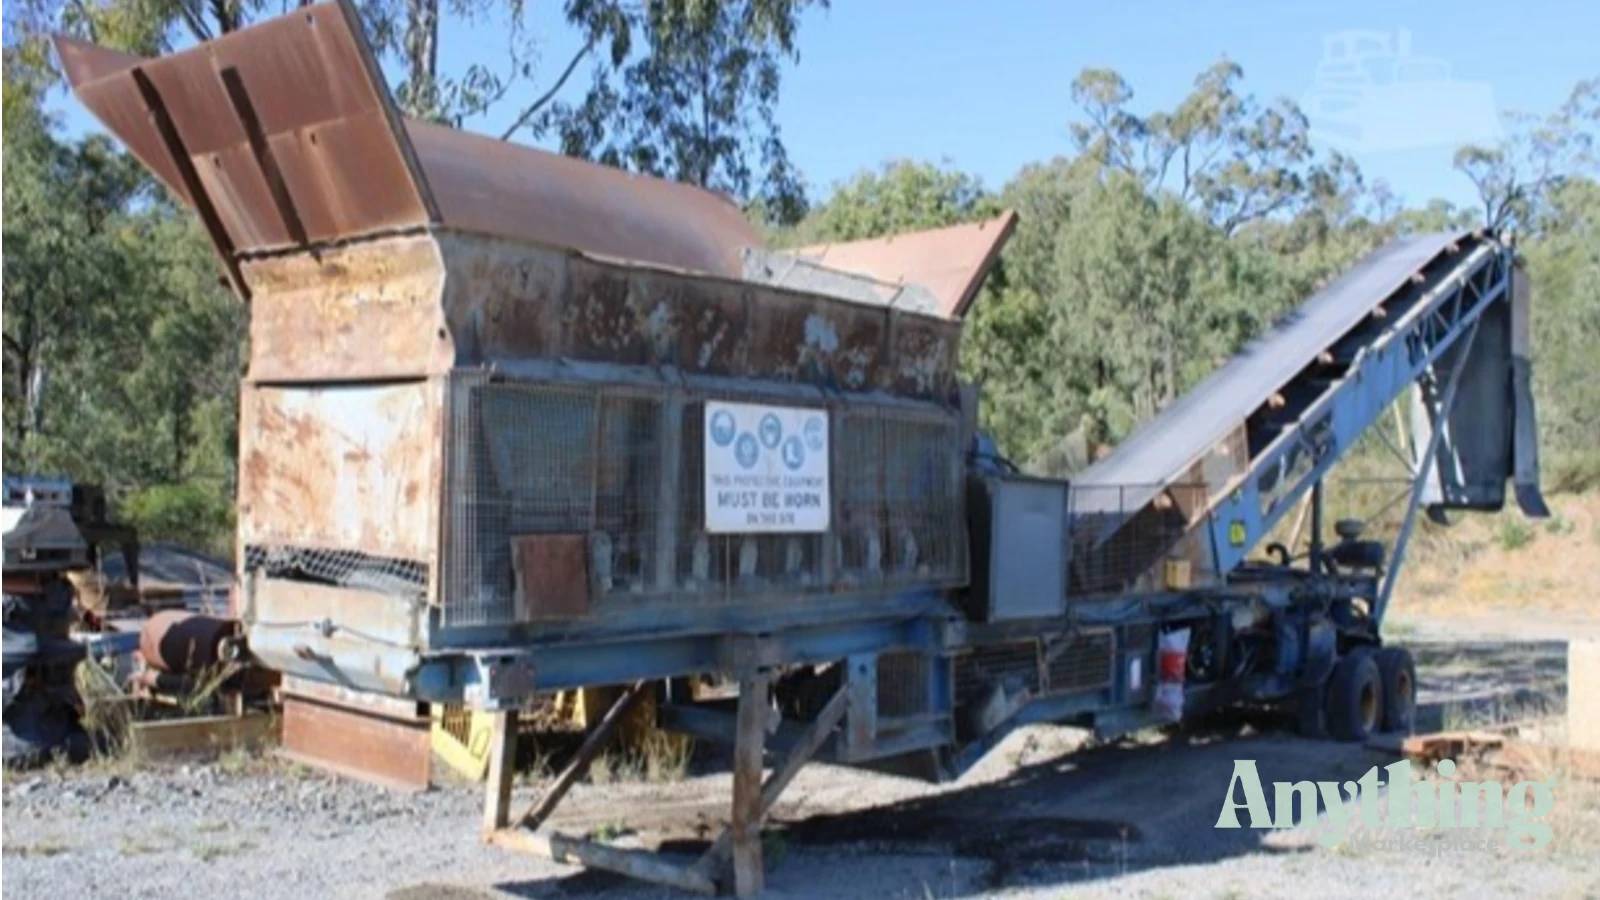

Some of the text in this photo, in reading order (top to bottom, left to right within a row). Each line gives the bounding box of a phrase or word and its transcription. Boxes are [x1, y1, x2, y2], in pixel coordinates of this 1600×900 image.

[717, 490, 821, 508] MUST BE WORN
